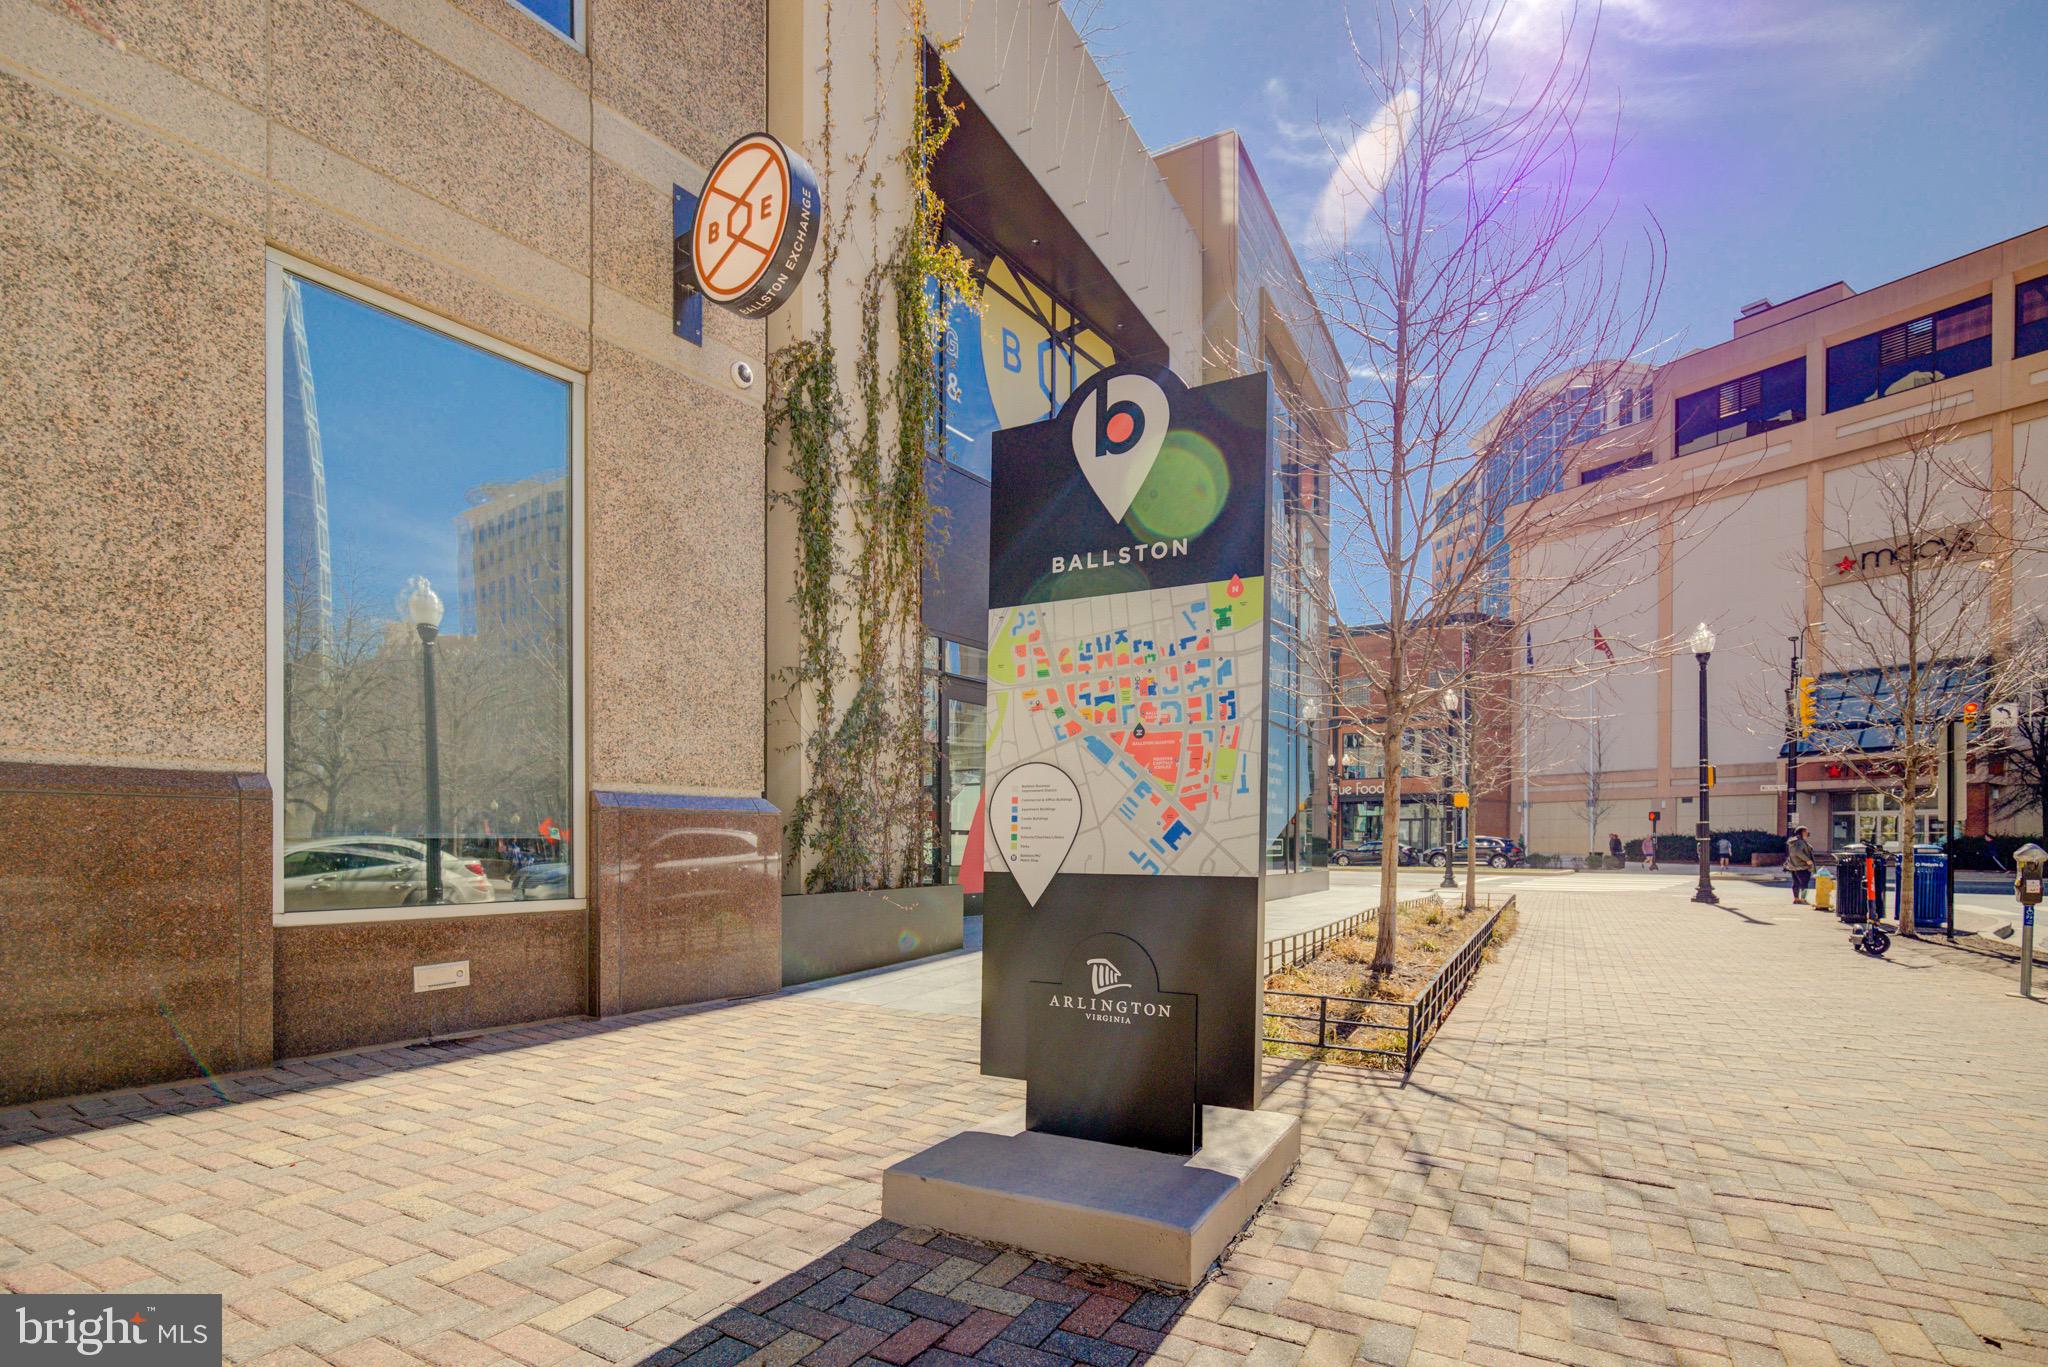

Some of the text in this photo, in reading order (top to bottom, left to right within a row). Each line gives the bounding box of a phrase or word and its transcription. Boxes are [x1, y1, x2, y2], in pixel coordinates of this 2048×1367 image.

[785, 187, 812, 271] EXCHANGE
[1051, 537, 1189, 575] BALLSTON
[1048, 994, 1172, 1018] ARLINGTON
[1085, 1012, 1132, 1025] VIRGINIA
